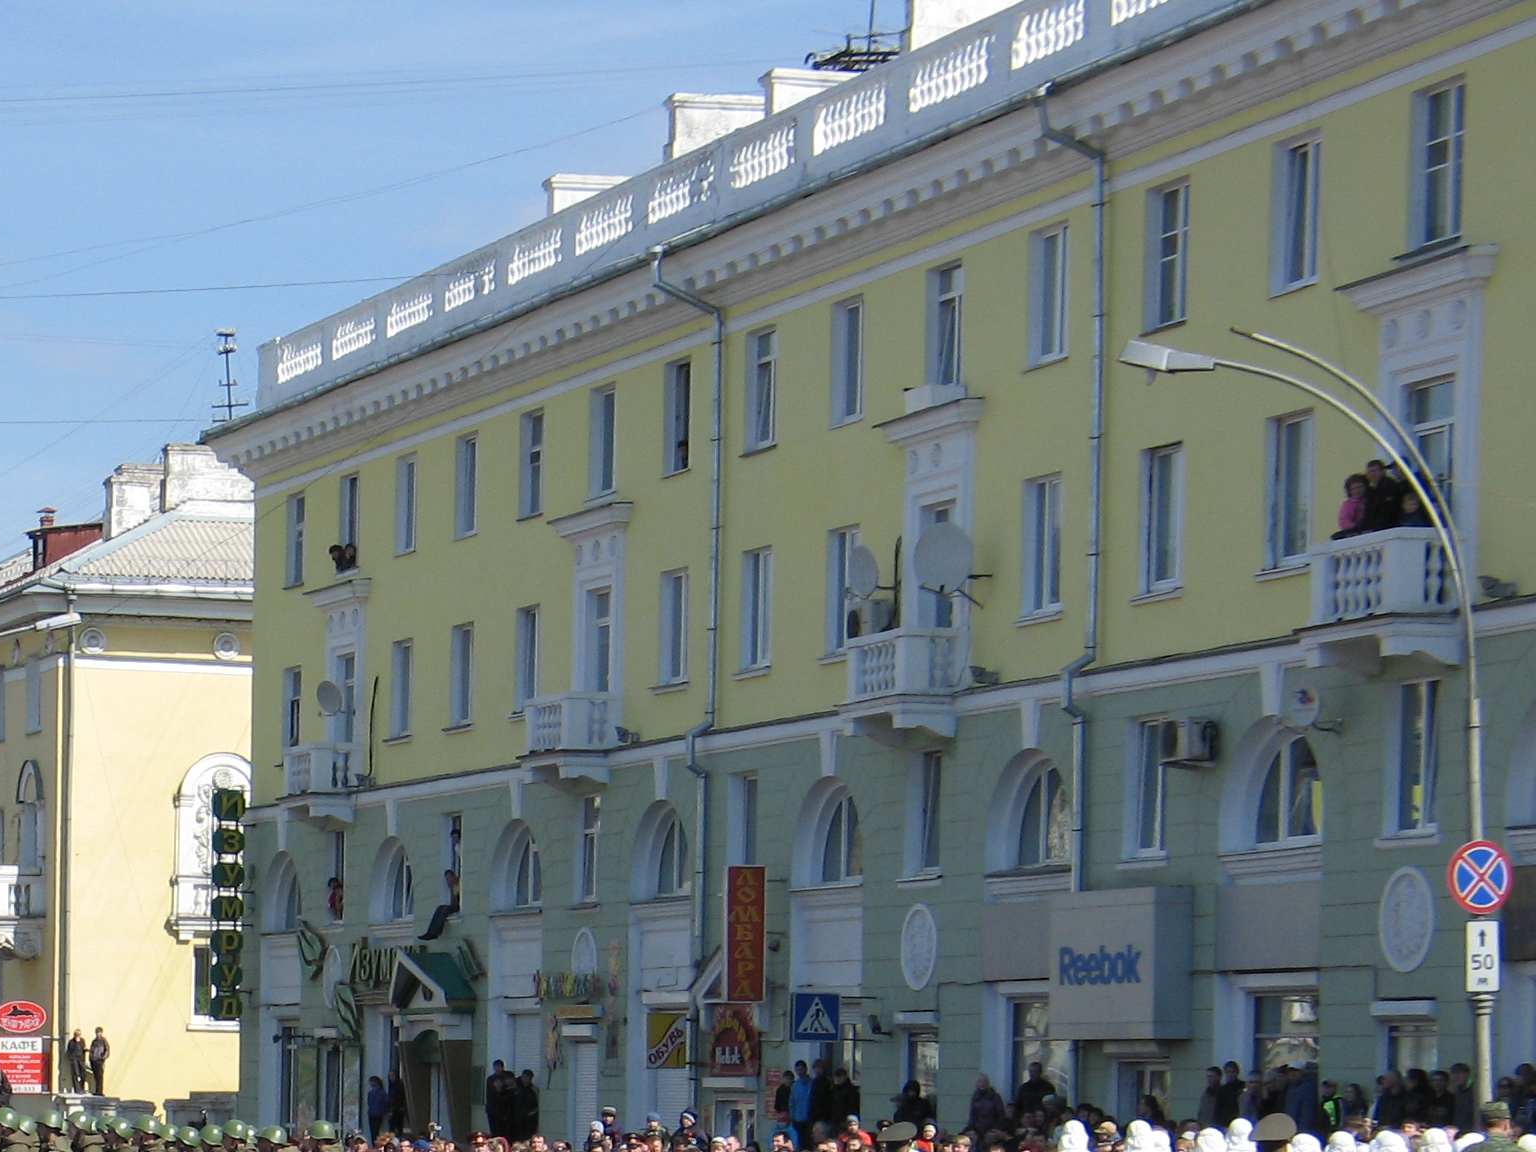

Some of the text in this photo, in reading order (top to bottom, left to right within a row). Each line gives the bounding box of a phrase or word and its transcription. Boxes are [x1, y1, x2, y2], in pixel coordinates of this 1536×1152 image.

[221, 794, 244, 1019] ИЗУМРУД
[729, 869, 762, 999] ЛОМБАРД
[1059, 944, 1142, 985] Reebok
[1471, 953, 1495, 971] 50
[1, 1040, 39, 1051] КАФЕ
[648, 1026, 684, 1065] ОБУВЬ
